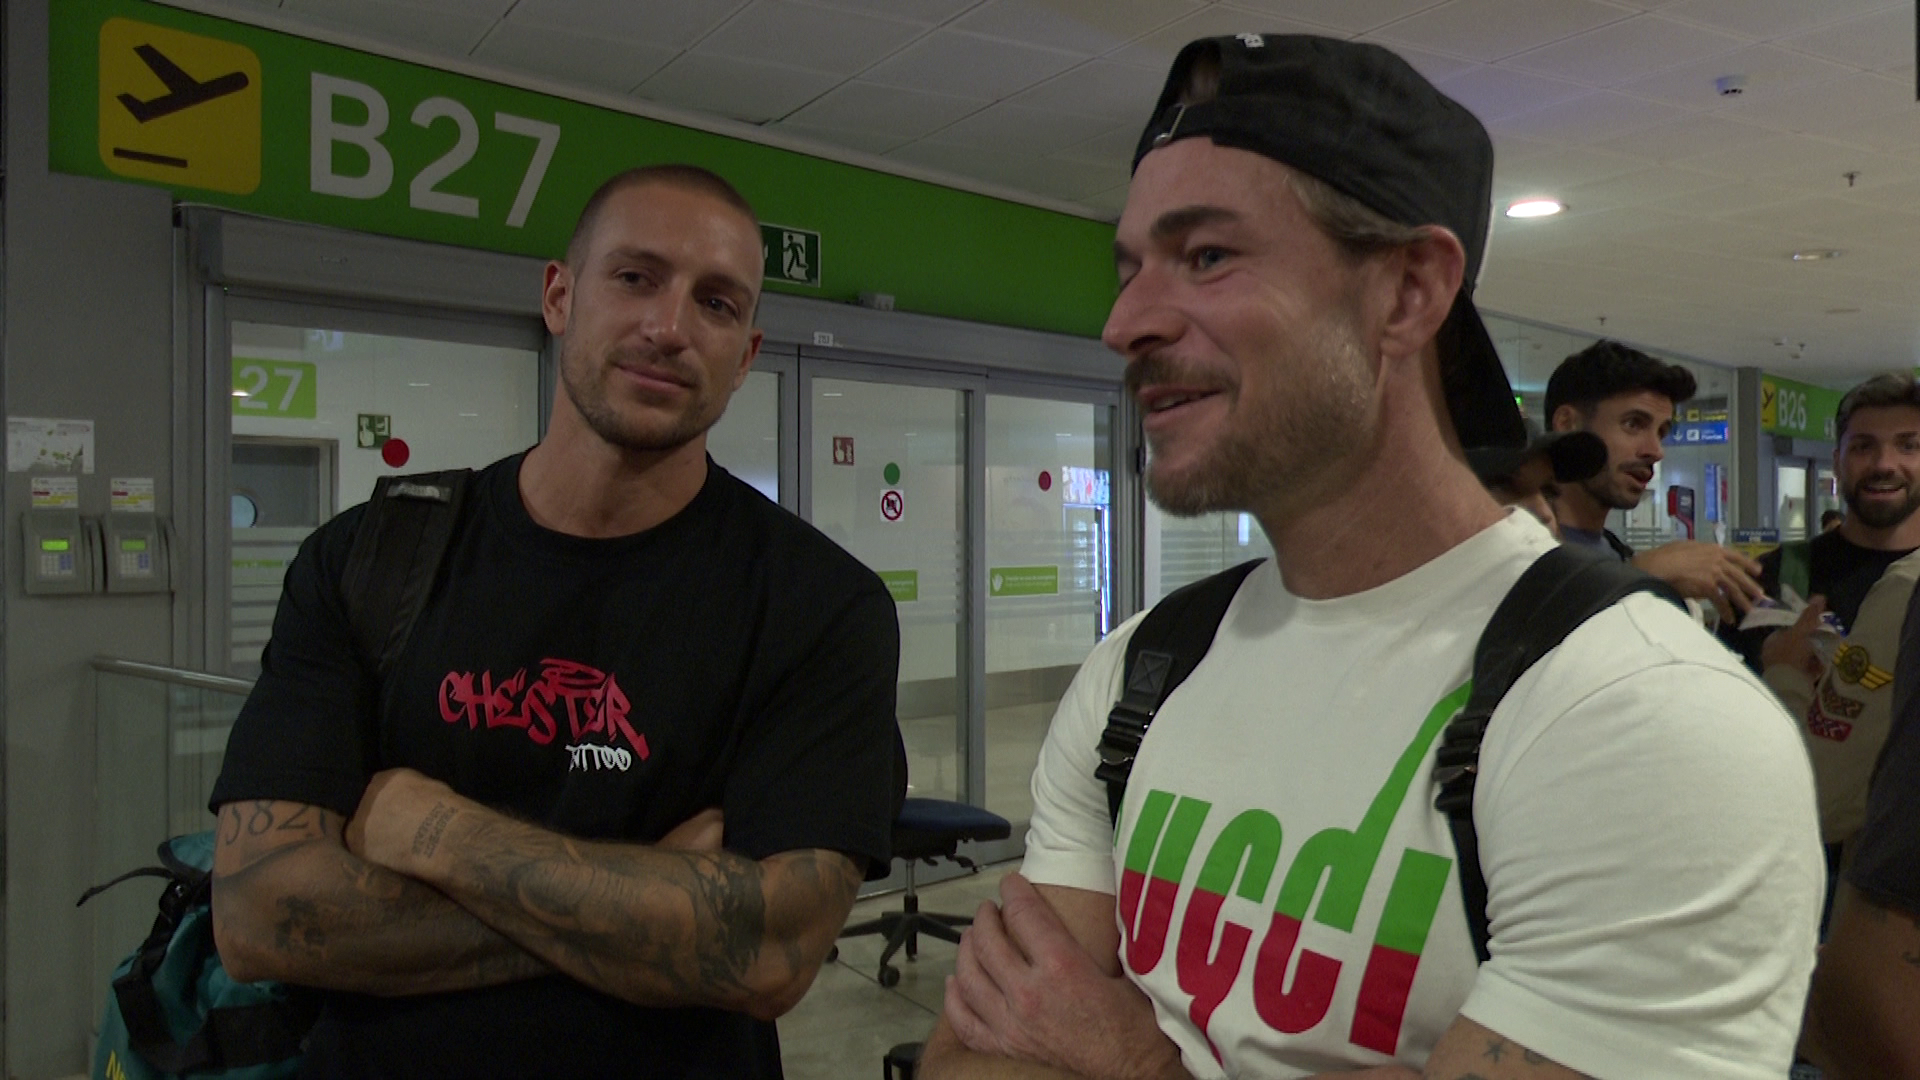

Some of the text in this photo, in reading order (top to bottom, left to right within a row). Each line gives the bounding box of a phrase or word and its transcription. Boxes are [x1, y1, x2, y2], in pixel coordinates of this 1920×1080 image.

[310, 71, 561, 229] B27
[239, 365, 303, 411] 27
[1778, 389, 1807, 430] B26
[438, 658, 650, 760] CHESTER
